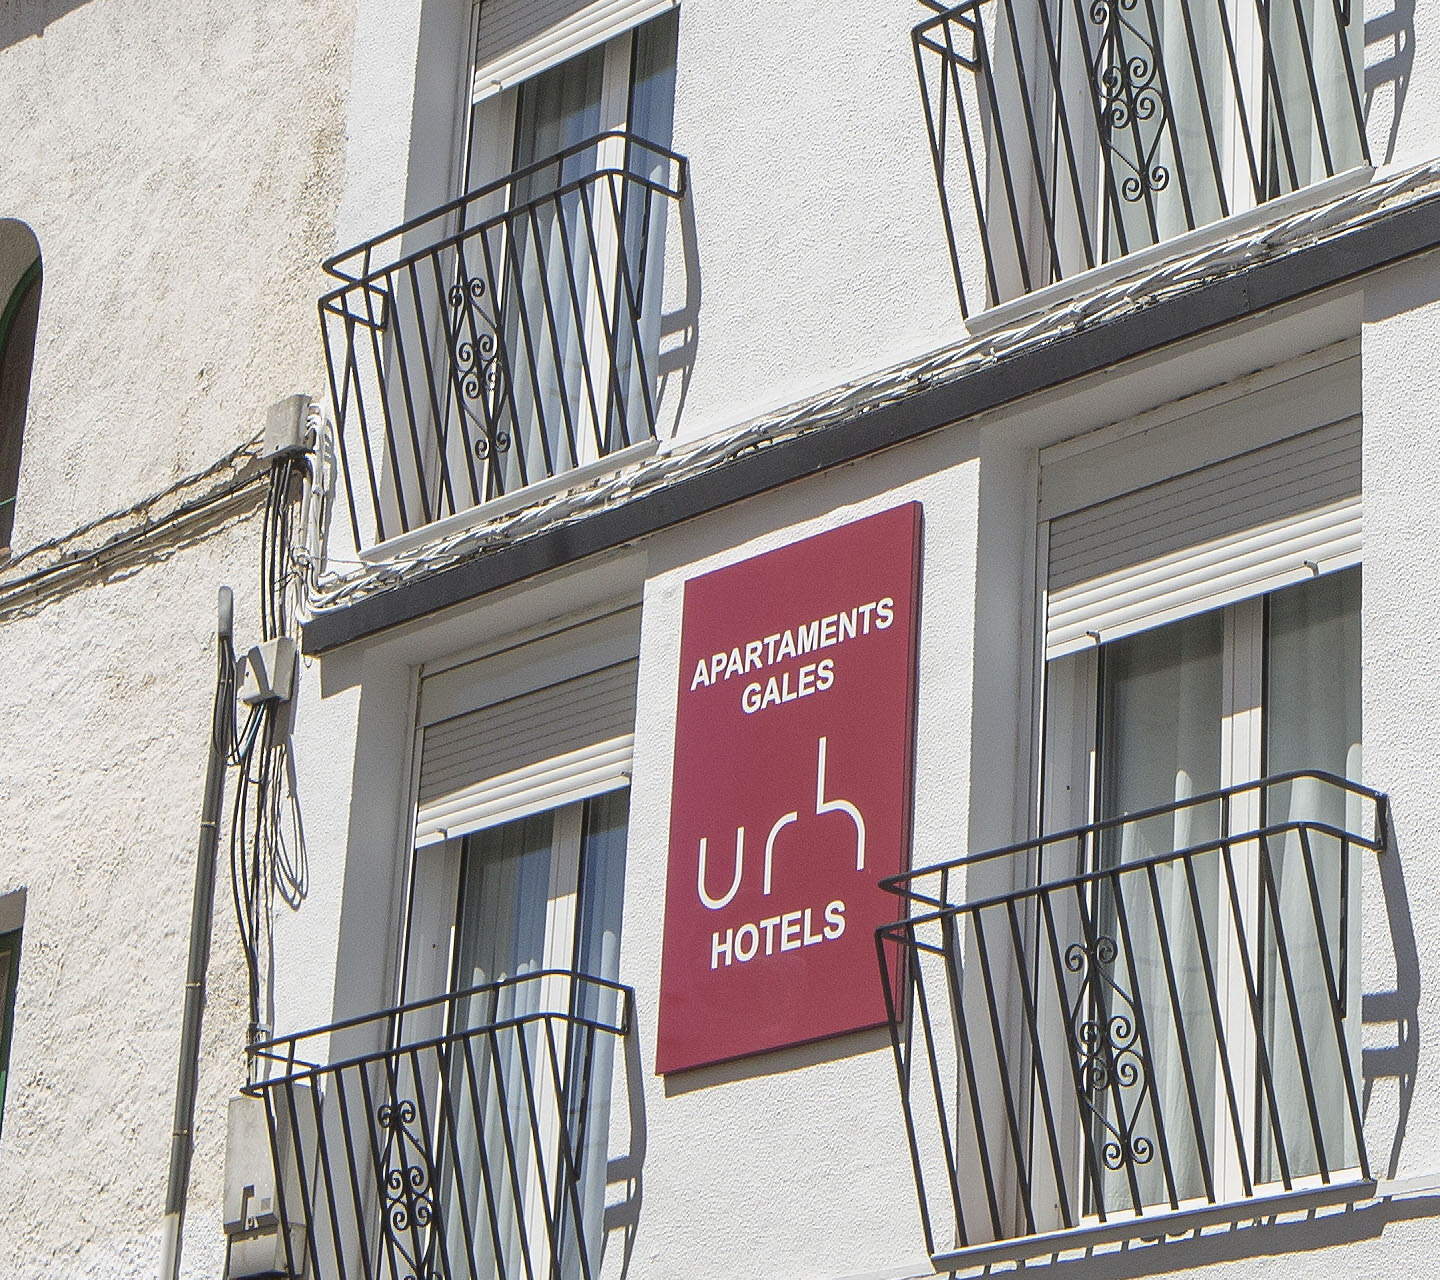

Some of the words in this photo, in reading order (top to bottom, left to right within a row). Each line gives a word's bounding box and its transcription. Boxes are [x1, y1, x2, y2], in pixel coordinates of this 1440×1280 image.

[690, 597, 894, 691] APARTAMENTS
[741, 658, 835, 714] GALES
[710, 899, 847, 970] HOTELS
